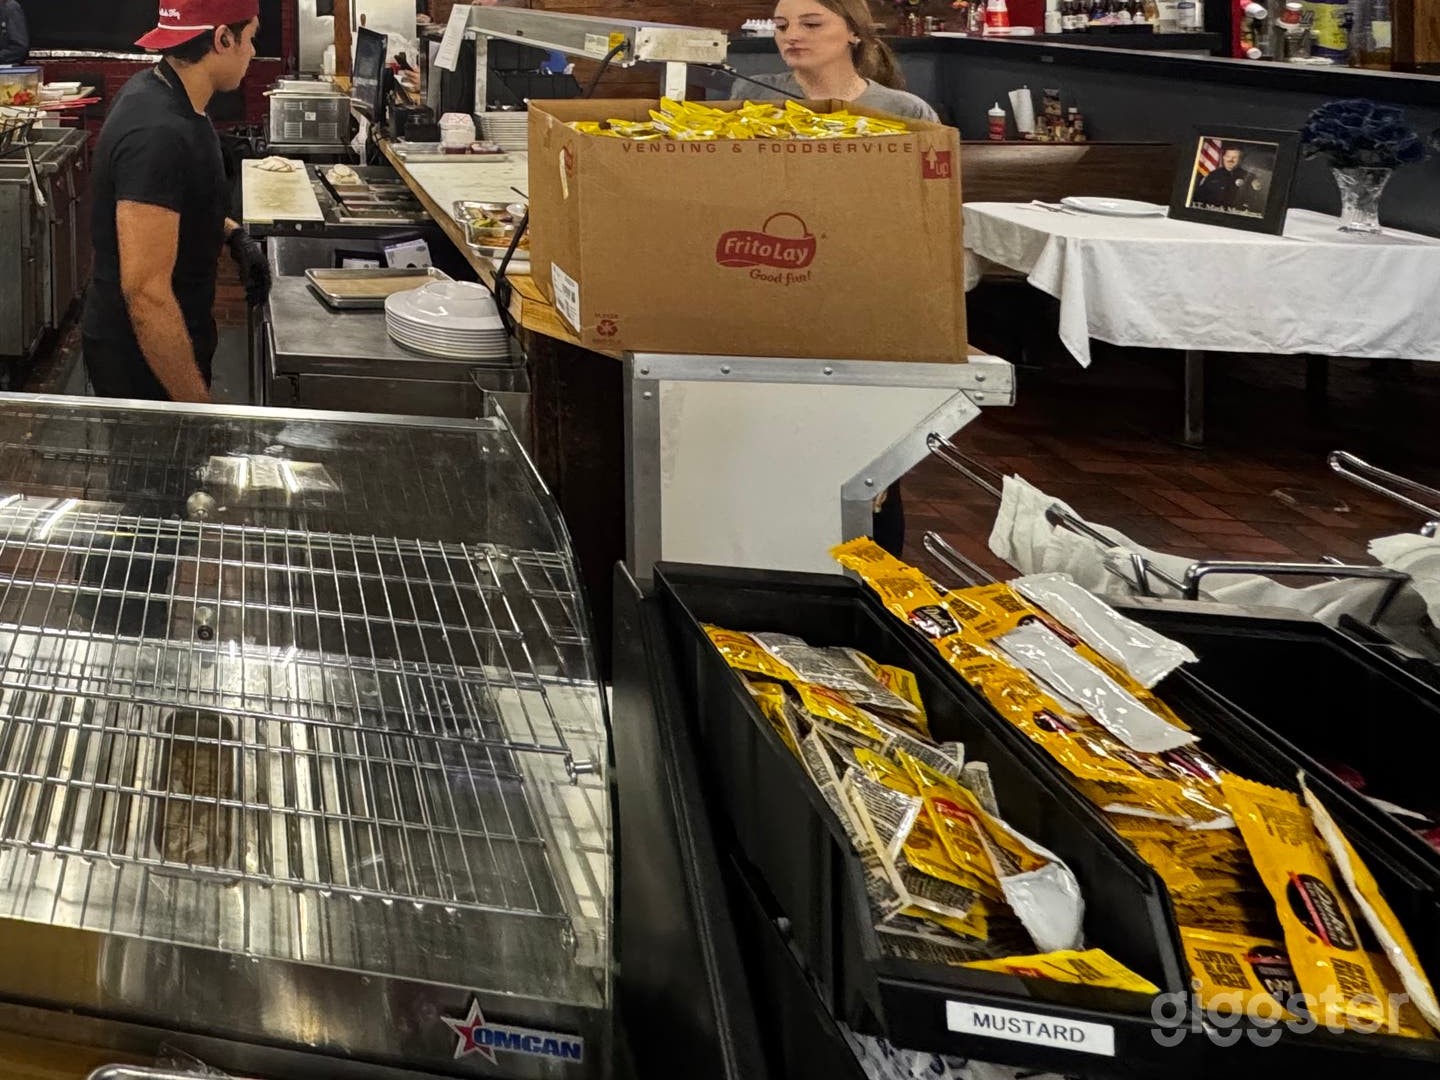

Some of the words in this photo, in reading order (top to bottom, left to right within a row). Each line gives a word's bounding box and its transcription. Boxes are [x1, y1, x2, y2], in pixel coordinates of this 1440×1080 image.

[622, 142, 717, 153] VENDING
[732, 144, 742, 153] &
[759, 142, 914, 154] FOODSERVICE
[936, 162, 948, 178] up
[750, 269, 782, 284] Good
[786, 270, 811, 286] fun!
[972, 1012, 1086, 1044] MUSTARD
[474, 1028, 580, 1060] OMCAN
